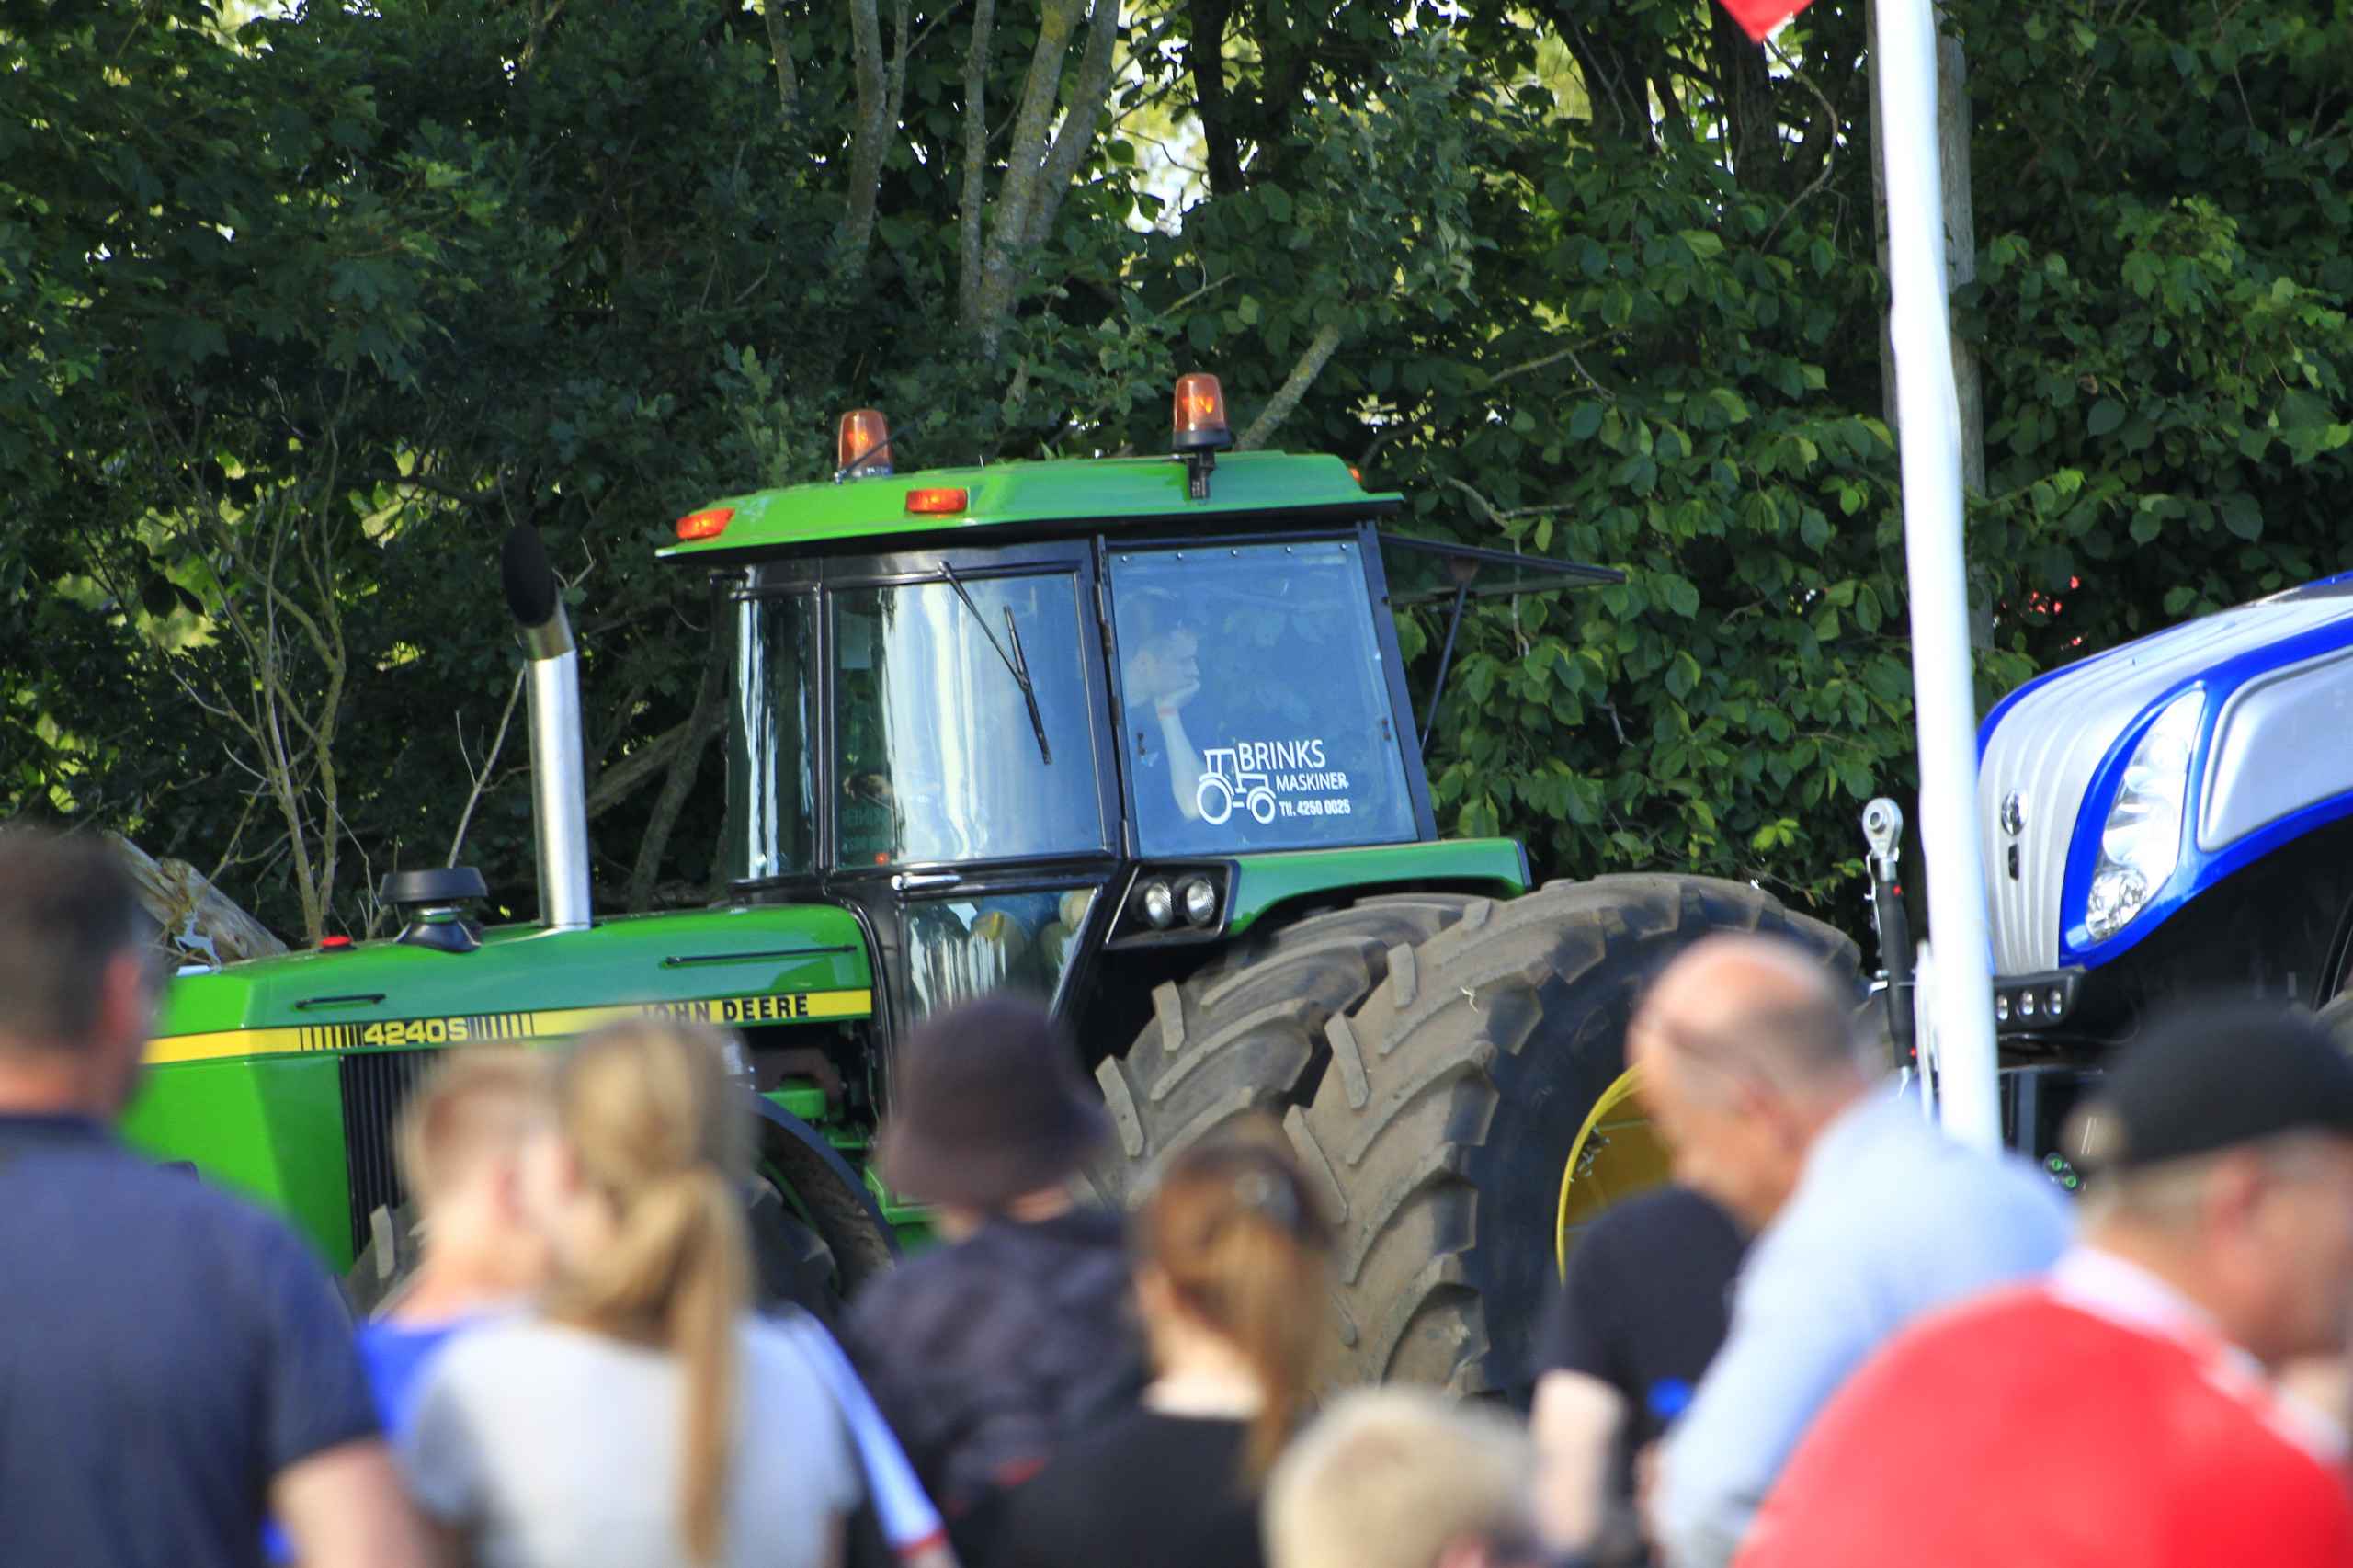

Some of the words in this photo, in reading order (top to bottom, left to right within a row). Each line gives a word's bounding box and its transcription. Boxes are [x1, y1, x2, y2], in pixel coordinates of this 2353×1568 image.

[1238, 739, 1326, 771] BRINKS
[1275, 772, 1349, 792] MASKINER
[722, 993, 810, 1022] DEERE
[364, 1017, 469, 1047] 4240S
